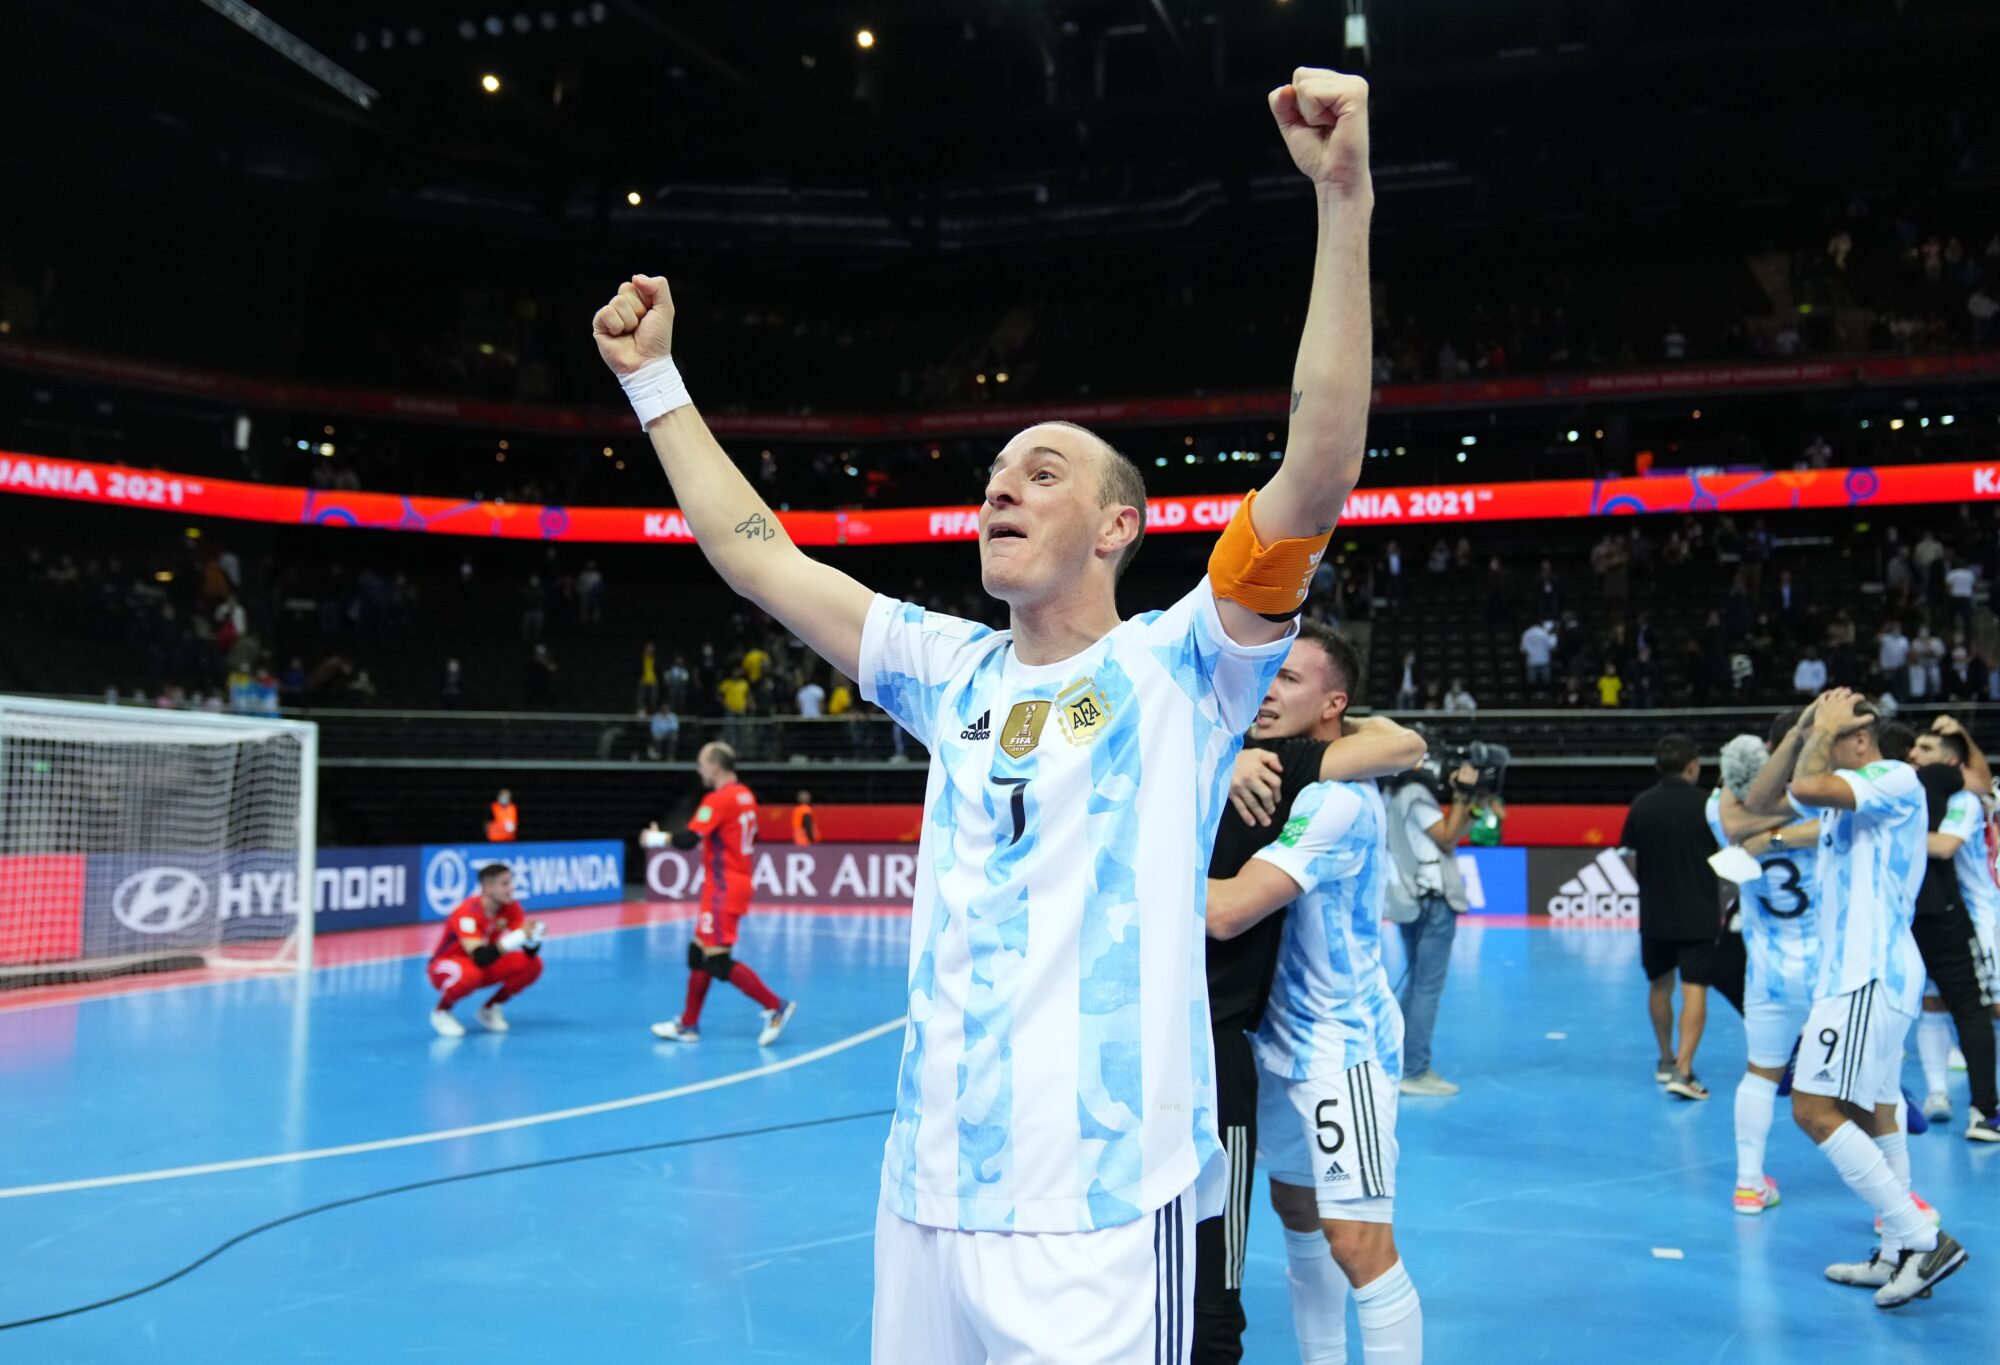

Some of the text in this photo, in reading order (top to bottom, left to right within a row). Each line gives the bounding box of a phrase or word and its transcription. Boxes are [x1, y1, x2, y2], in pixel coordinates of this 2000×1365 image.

[1973, 467, 2000, 494] K
[644, 513, 694, 538] KA
[930, 512, 979, 537] FIFA
[1070, 697, 1101, 730] AFA
[960, 728, 991, 741] adidas
[1010, 736, 1032, 745] FIFA
[991, 775, 1032, 848] 7
[530, 854, 620, 896] WANDA
[646, 851, 817, 899] QAR
[1759, 858, 1810, 920] 3
[1548, 892, 1640, 918] adida
[1819, 1028, 1839, 1065] 9
[1315, 1098, 1345, 1155] 5
